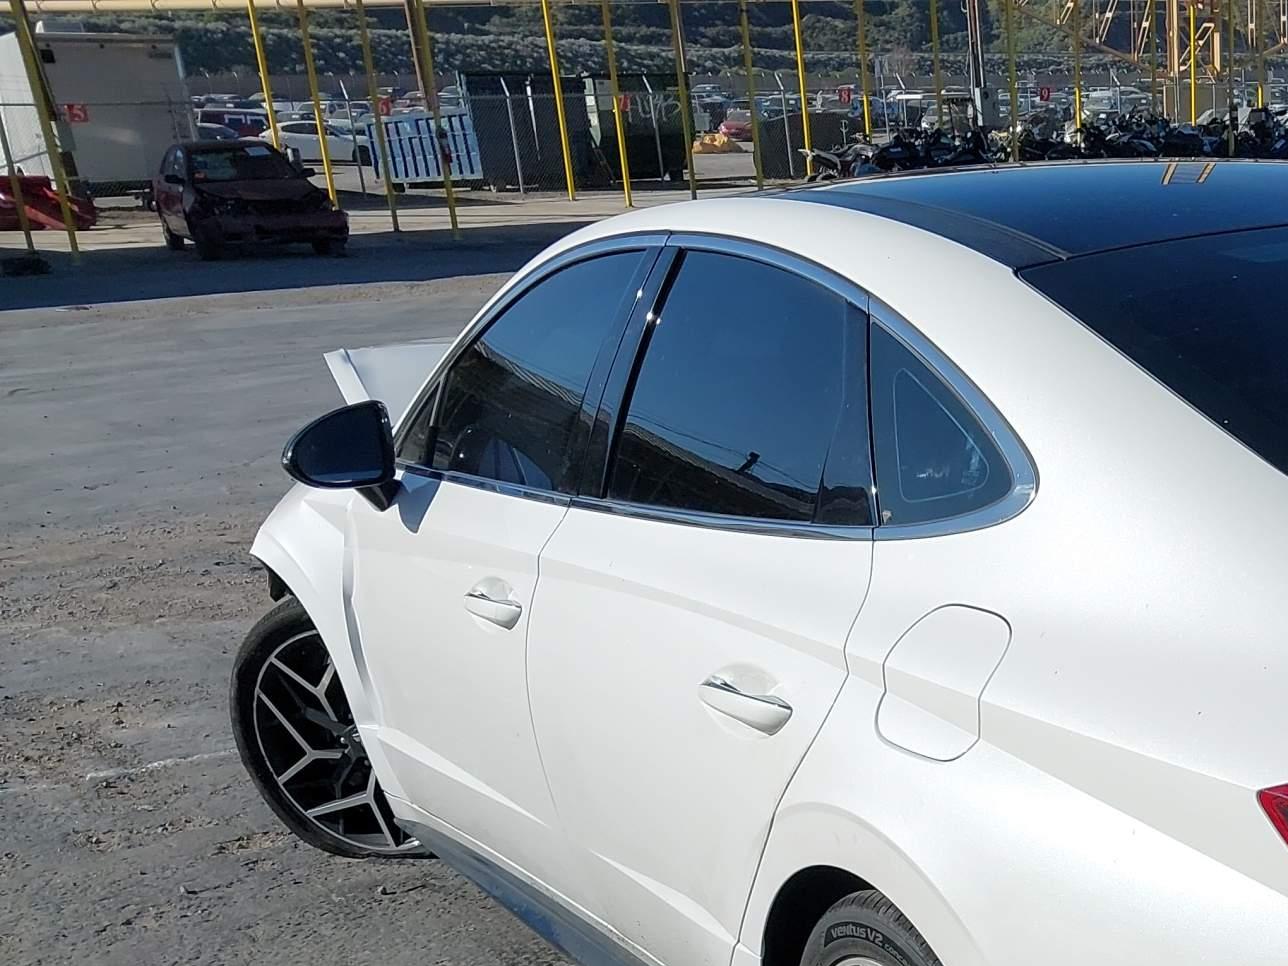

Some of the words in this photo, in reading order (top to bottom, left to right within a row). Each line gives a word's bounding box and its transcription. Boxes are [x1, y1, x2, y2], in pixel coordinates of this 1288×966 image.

[841, 89, 849, 104] 8
[73, 104, 85, 121] 5
[867, 927, 883, 946] V2
